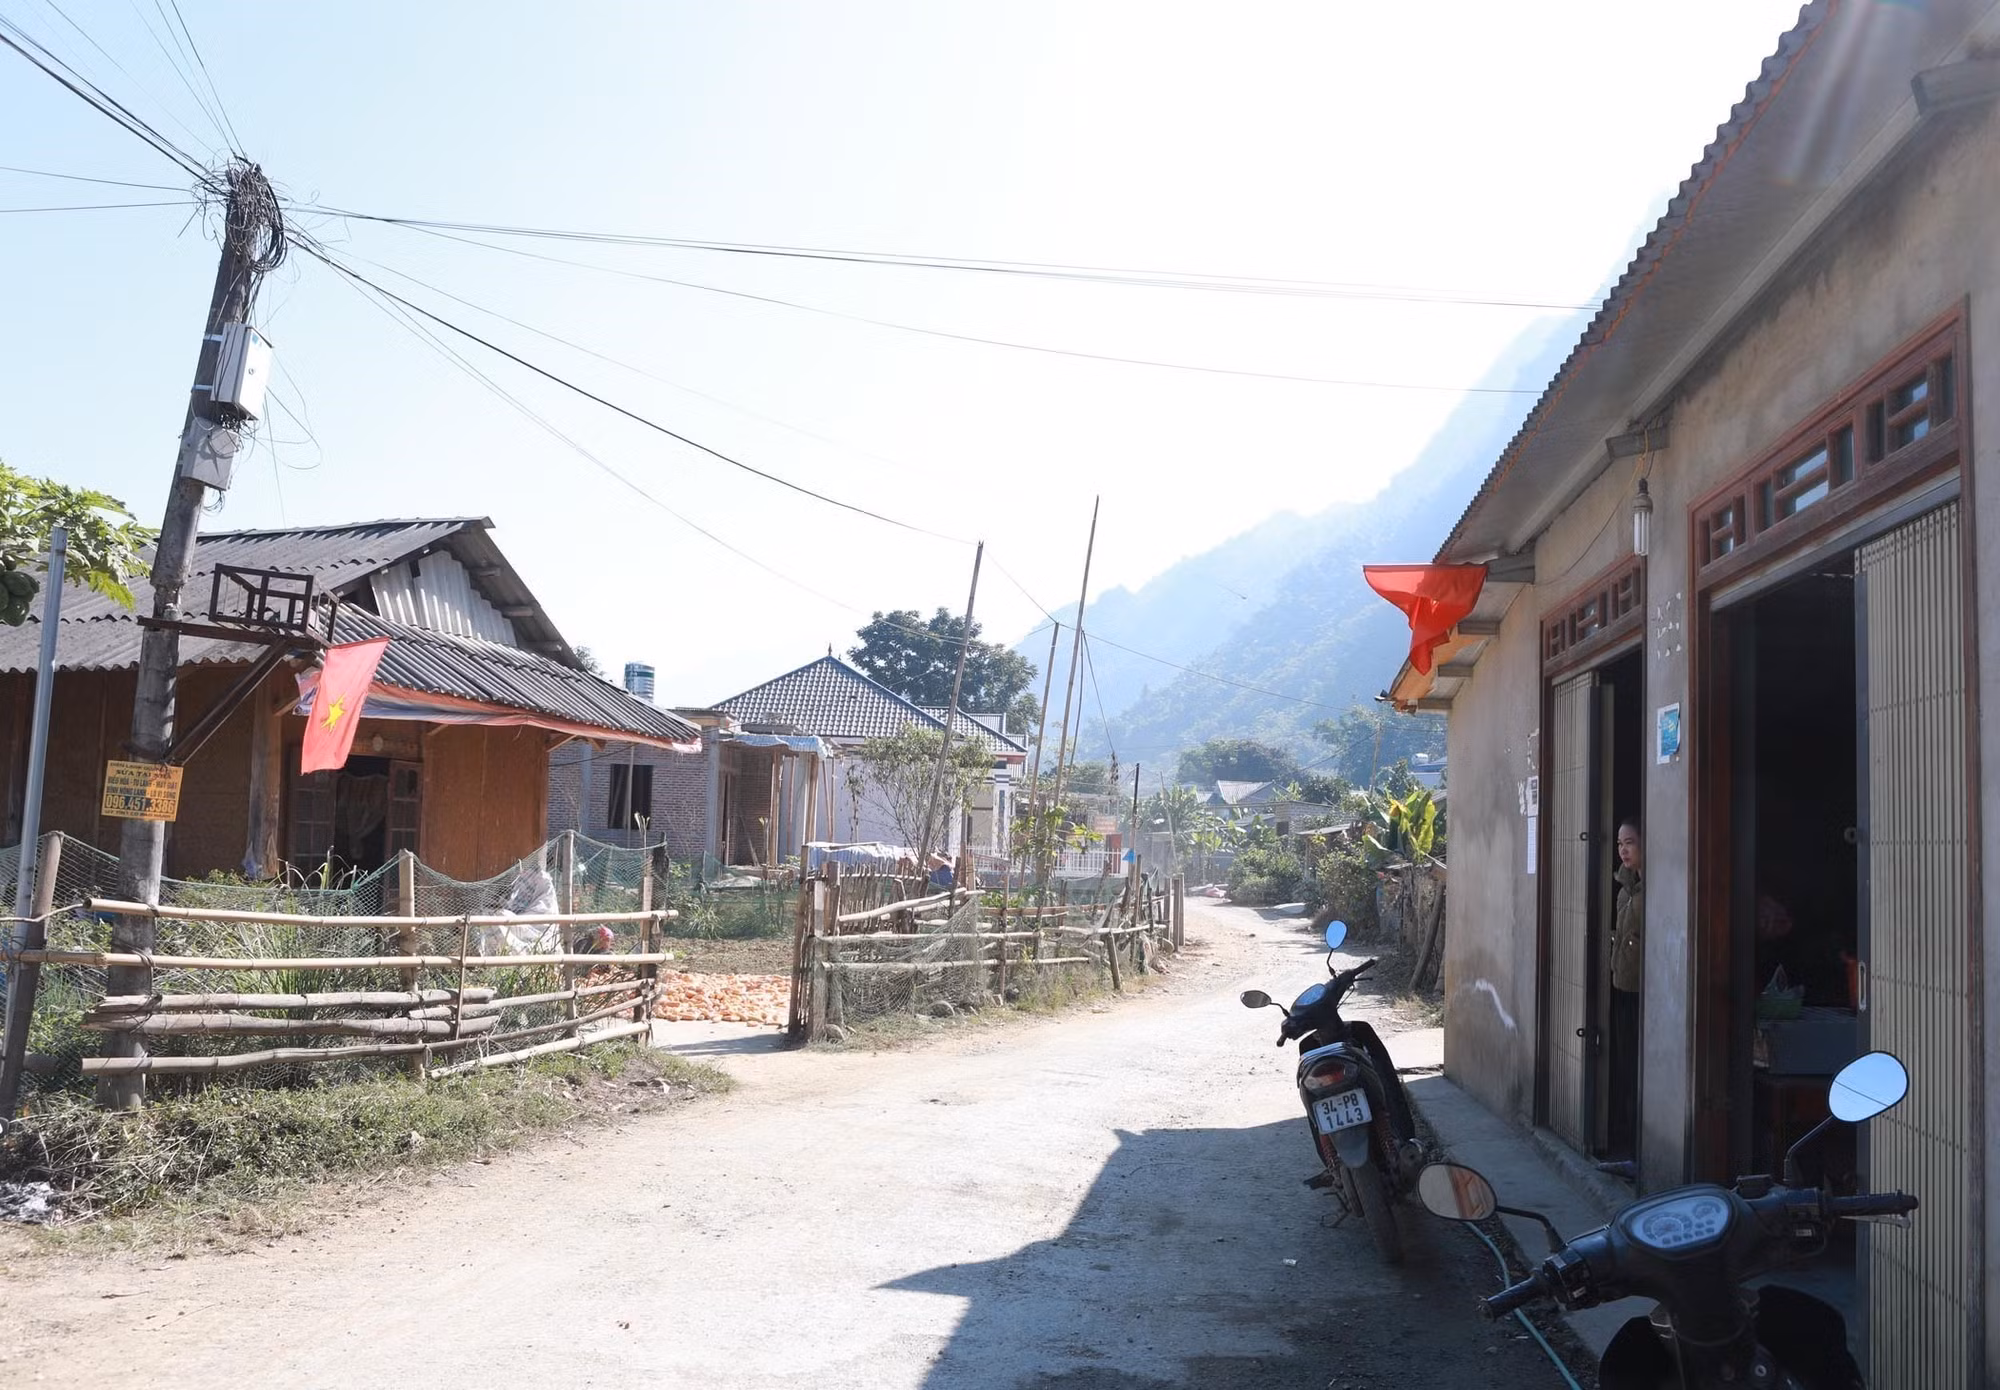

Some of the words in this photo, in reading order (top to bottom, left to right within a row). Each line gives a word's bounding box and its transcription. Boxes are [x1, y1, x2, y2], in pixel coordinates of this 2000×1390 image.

[106, 795, 175, 813] 096.451.3386
[1322, 1093, 1359, 1115] 34-P8
[1326, 1107, 1364, 1129] 1443
